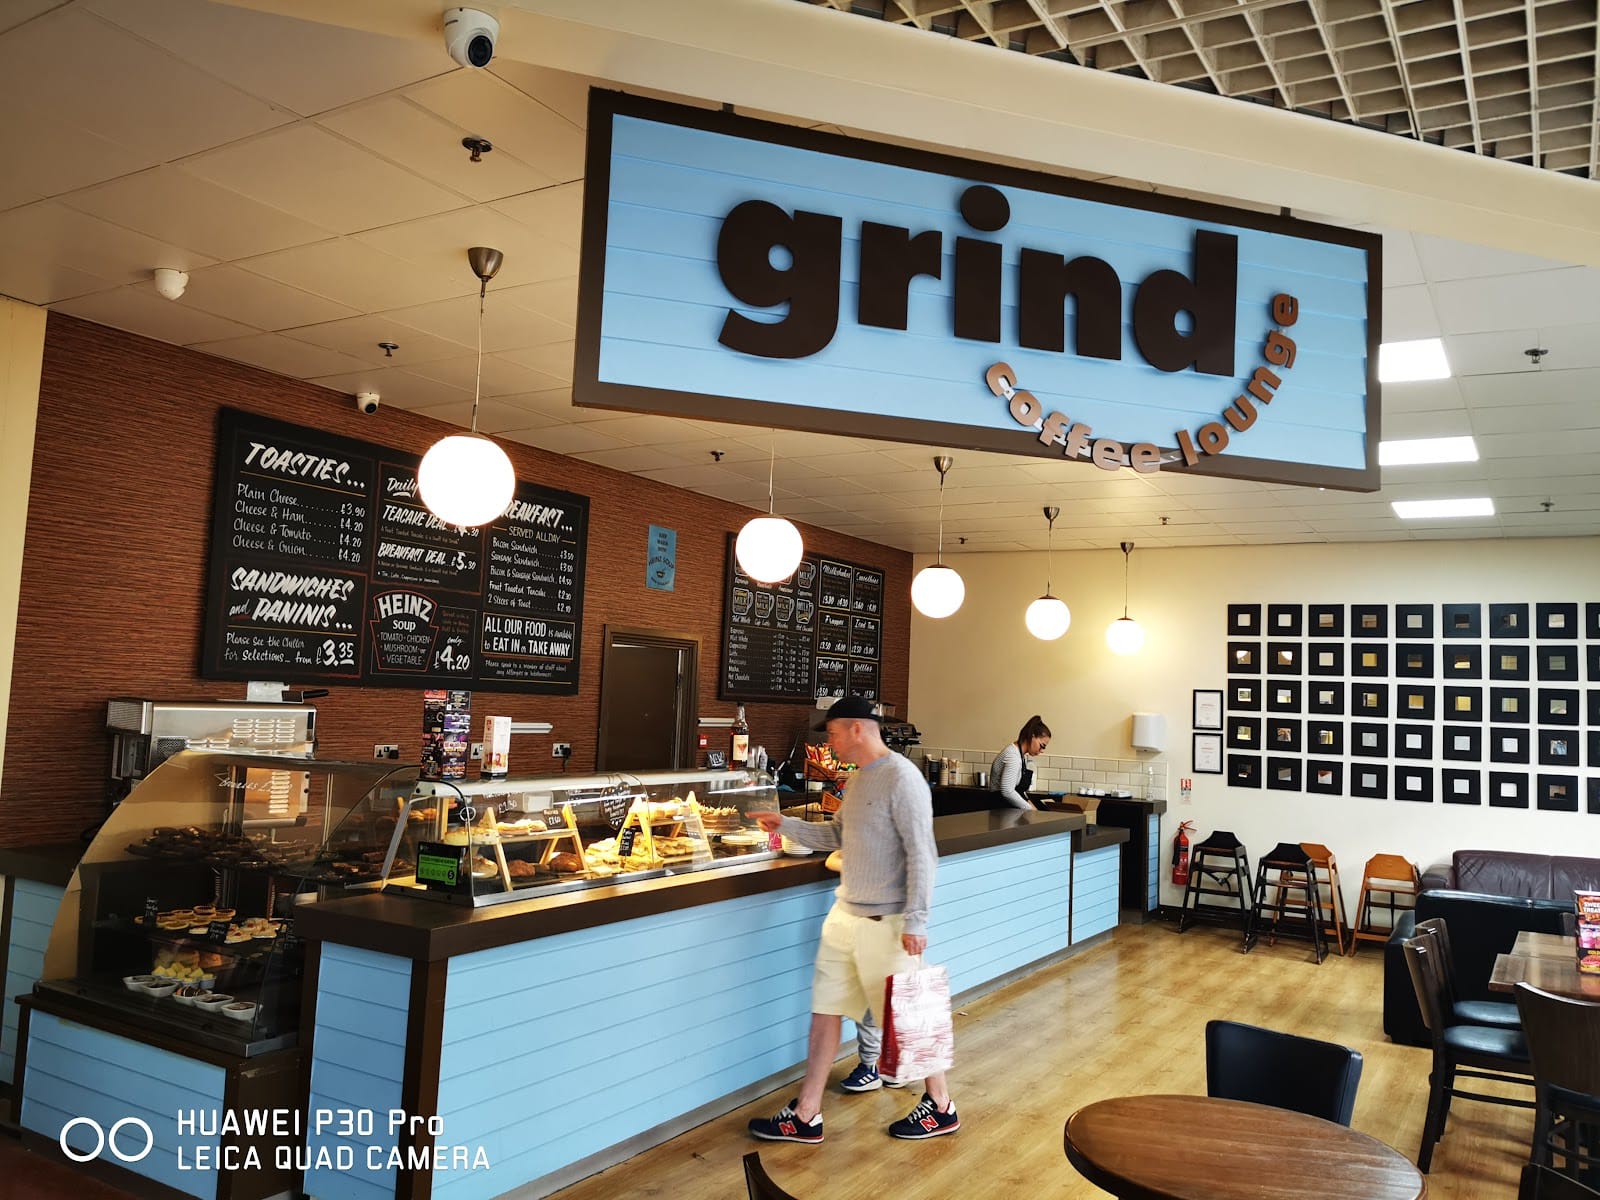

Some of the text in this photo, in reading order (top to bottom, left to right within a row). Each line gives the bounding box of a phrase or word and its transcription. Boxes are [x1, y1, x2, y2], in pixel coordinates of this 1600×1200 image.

[717, 185, 1238, 377] grind
[984, 293, 1299, 473] coffee lounge
[387, 477, 418, 498] Daily
[237, 483, 366, 518] Plain Cheese £3.90
[235, 500, 364, 533] Cheese & Ham £4.20
[382, 504, 427, 527] TEACAKE
[233, 518, 362, 548] Cheese & Tomato £4.20
[508, 526, 534, 539] SERVED
[233, 535, 361, 563] Cheese & Onion £4.20
[377, 542, 425, 562] BREAKFAST
[425, 549, 447, 565] DEAL
[492, 537, 509, 549] Bacon
[511, 541, 538, 554] Sandwich
[491, 551, 512, 563] Sausage
[514, 553, 540, 567] Sandwich
[230, 566, 355, 602] SANDWICHES
[490, 565, 506, 576] Bacon
[511, 568, 531, 581] Sausage
[531, 571, 555, 583] Sandwich
[504, 583, 524, 594] Toasted
[229, 598, 251, 616] and
[377, 593, 433, 622] HEINZ
[487, 593, 493, 603] 2
[493, 595, 509, 607] Slices
[517, 598, 531, 609] Toast
[485, 616, 502, 633] ALL
[504, 618, 523, 635] OUR
[525, 620, 547, 637] FOOD
[226, 632, 250, 645] Please
[267, 636, 281, 648] the
[493, 637, 509, 651] EAT
[511, 638, 521, 652] IN
[528, 639, 549, 655] TAKE
[549, 643, 571, 657] AWAY
[224, 648, 238, 661] for
[295, 651, 312, 665] from
[386, 654, 423, 665] VEGETABLE
[433, 645, 470, 670] £4.20
